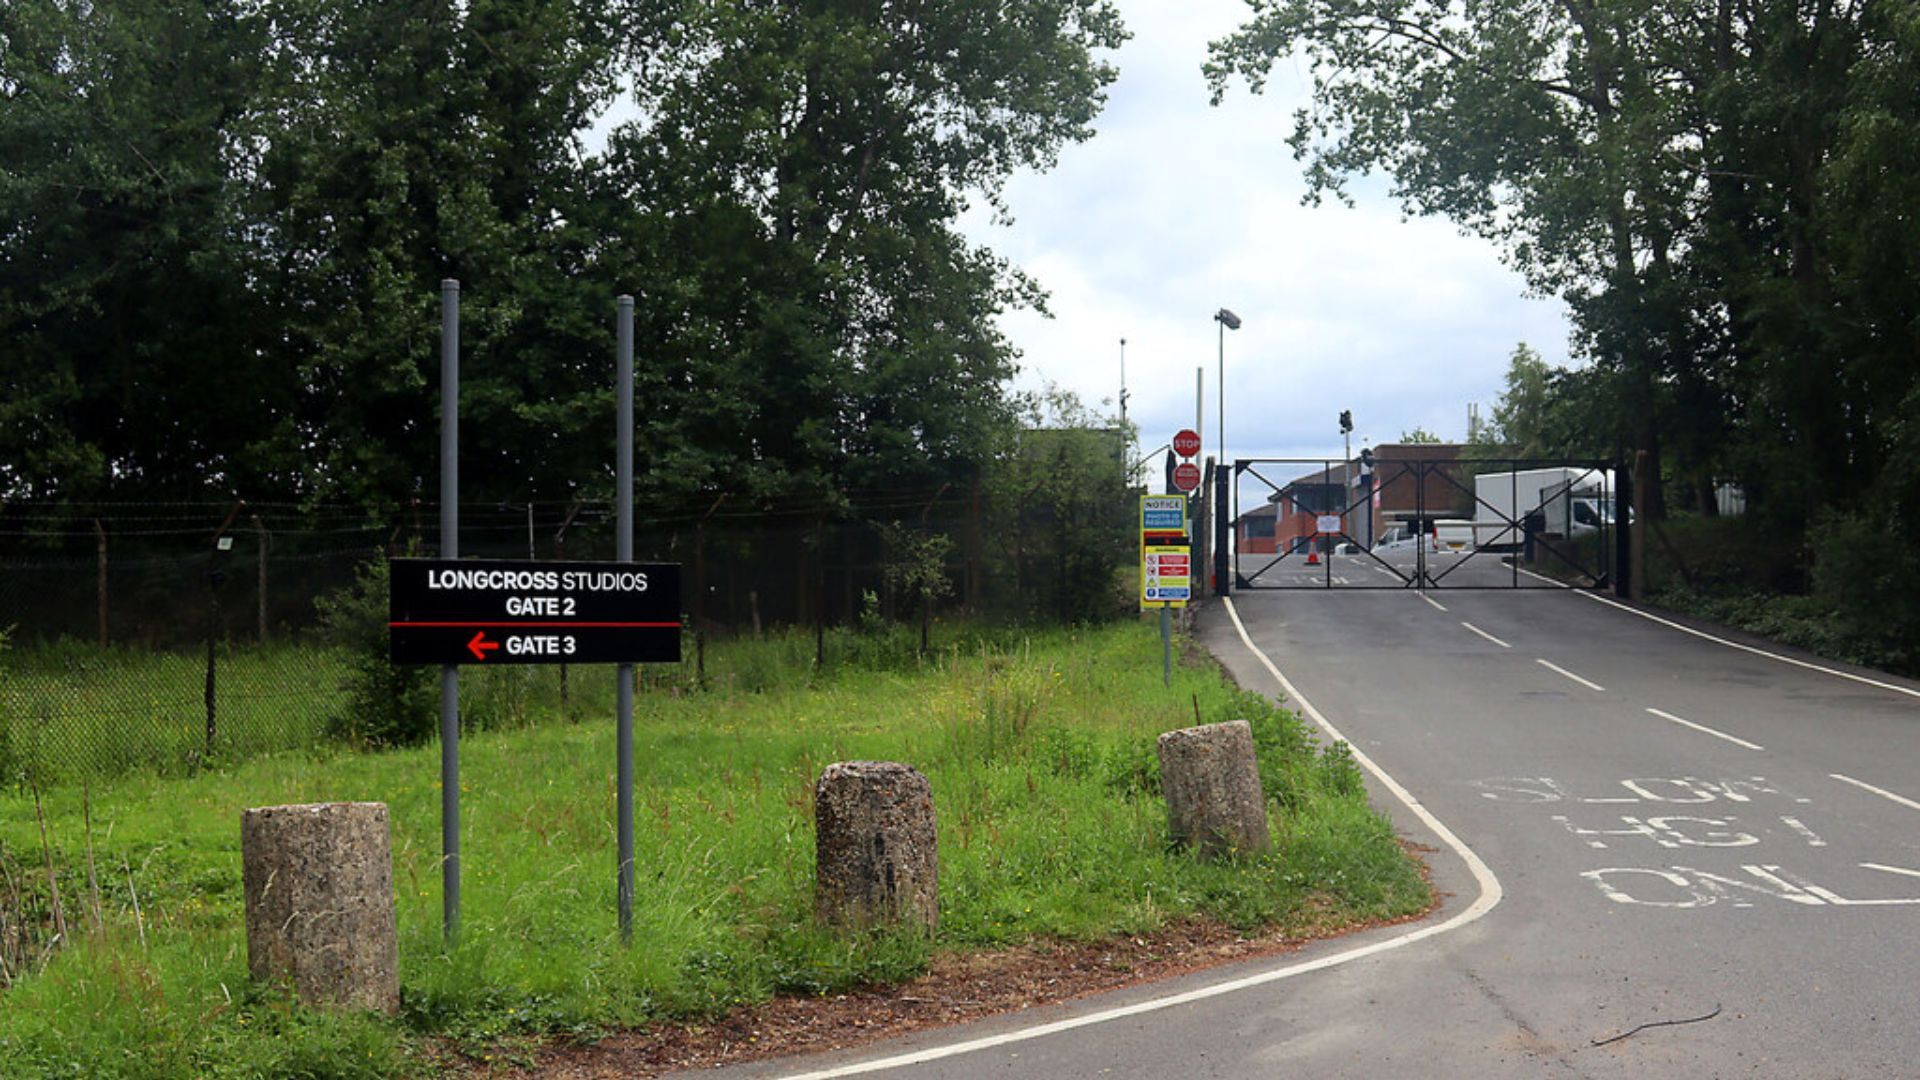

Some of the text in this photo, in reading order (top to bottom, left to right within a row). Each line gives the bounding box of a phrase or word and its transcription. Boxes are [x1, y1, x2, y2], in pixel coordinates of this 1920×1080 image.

[1175, 440, 1200, 449] STOP
[1145, 500, 1180, 509] NOTICE
[428, 570, 648, 592] LONGCROSS STUDIOS
[505, 597, 576, 616] GATE 2
[505, 635, 577, 655] GATE 3
